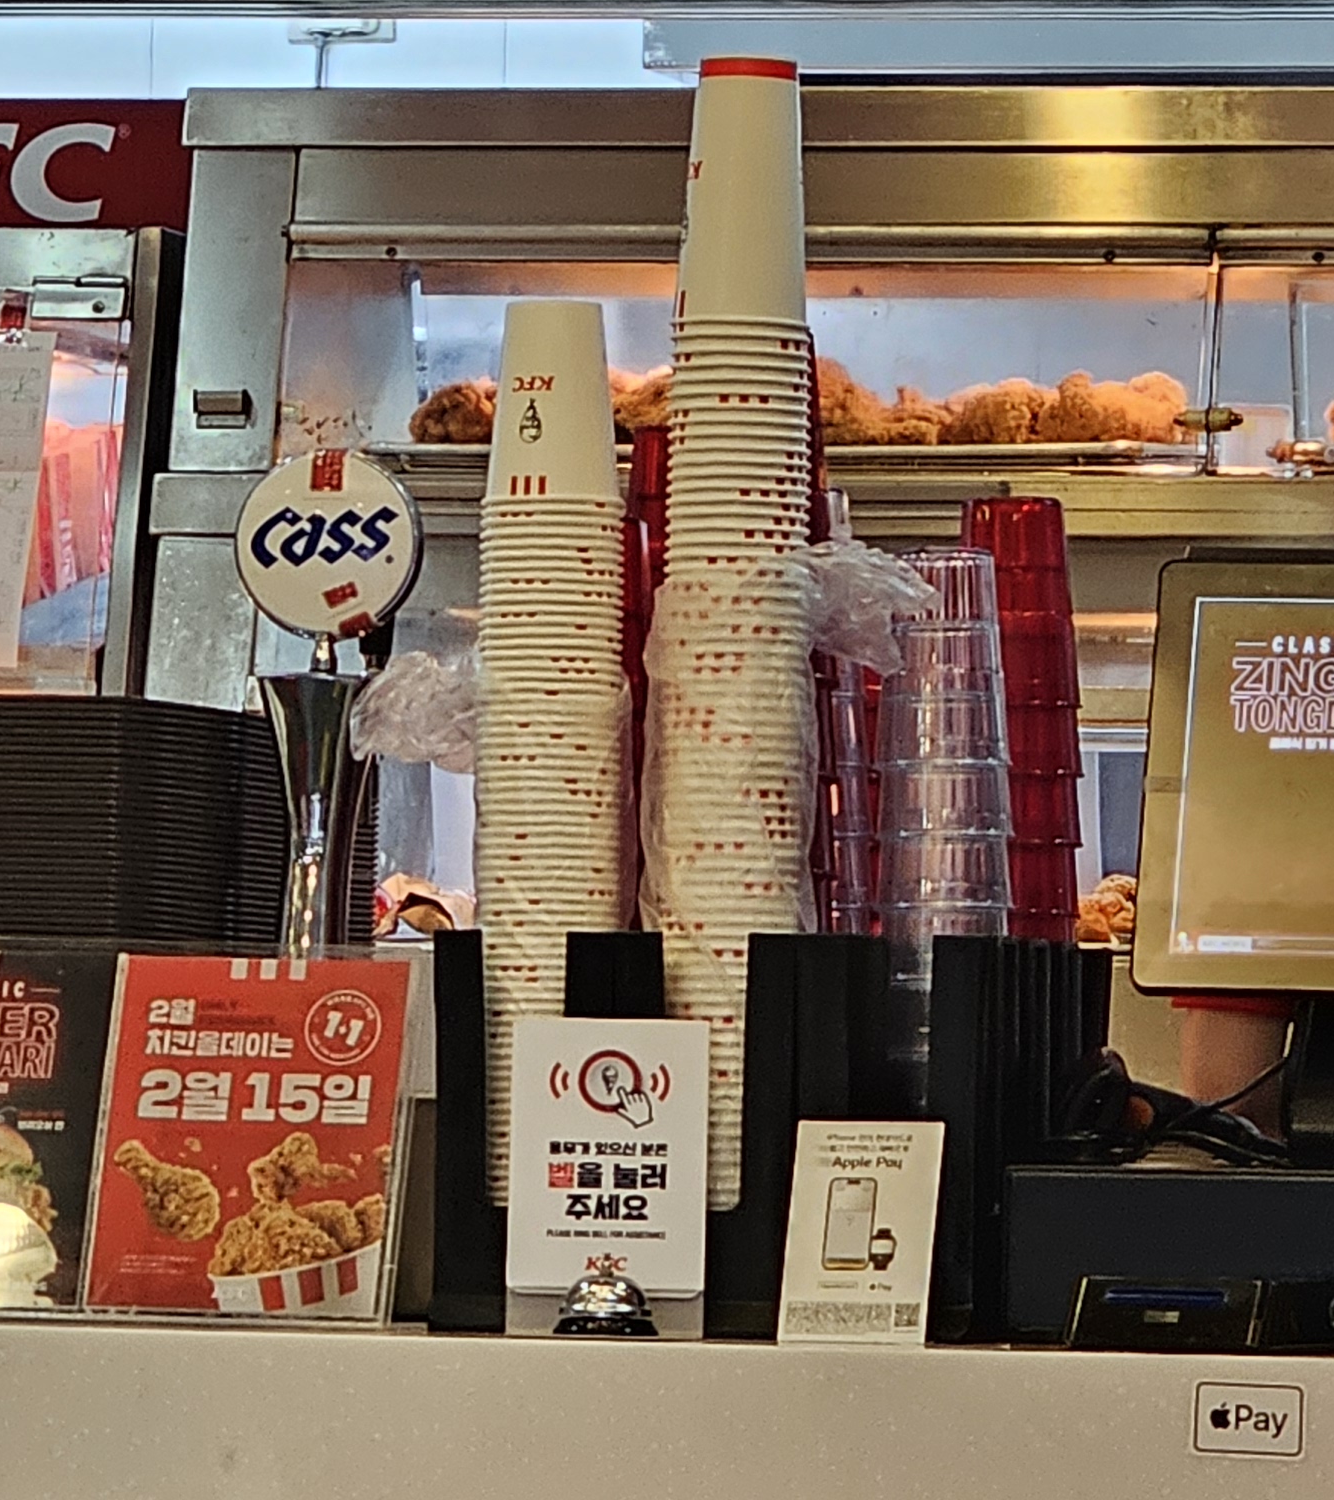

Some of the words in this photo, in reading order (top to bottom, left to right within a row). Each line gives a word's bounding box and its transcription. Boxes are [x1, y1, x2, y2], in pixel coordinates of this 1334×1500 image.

[511, 375, 556, 394] KFC
[250, 506, 400, 570] Cass
[148, 998, 197, 1026] 2월
[144, 1028, 295, 1059] 치킨올데이는
[137, 1068, 233, 1122] 2월
[241, 1071, 373, 1125] 15일
[548, 1161, 604, 1189] 벨을
[613, 1163, 668, 1190] 눌러
[831, 1155, 872, 1171] Apple
[875, 1156, 904, 1171] Pay
[565, 1193, 649, 1221] 주세요
[585, 1256, 628, 1272] KC
[1233, 1404, 1289, 1438] Pay
